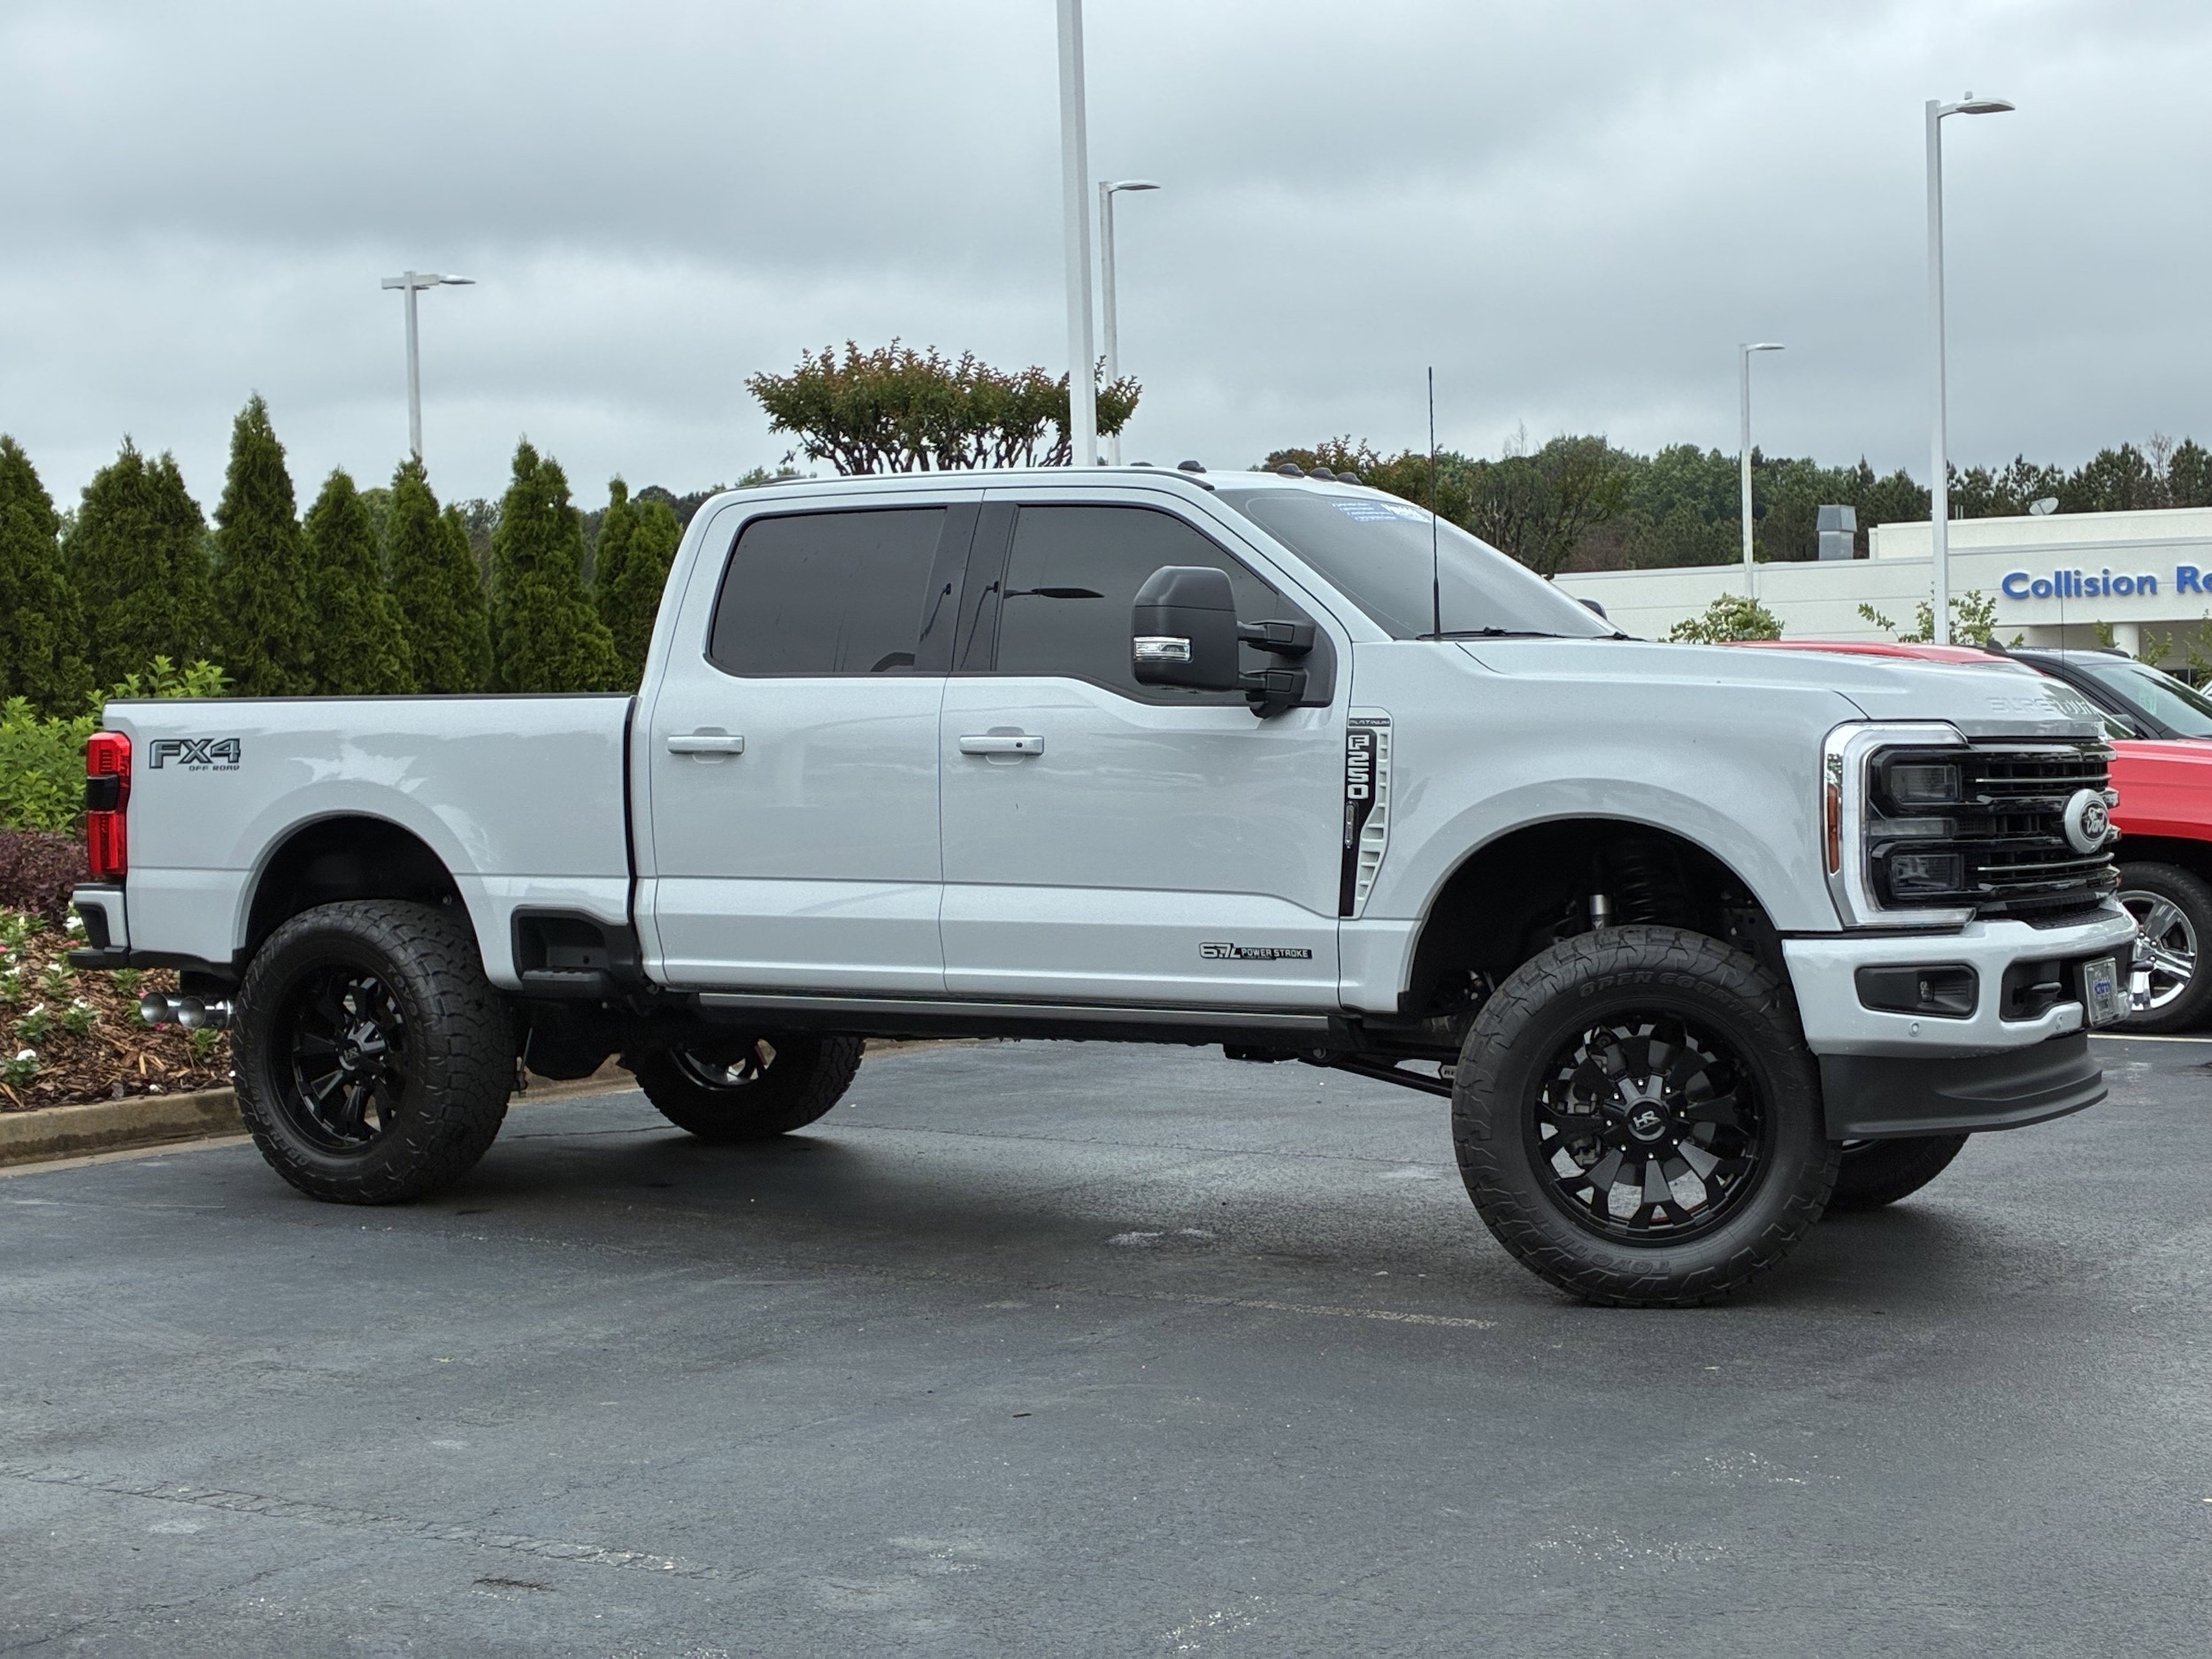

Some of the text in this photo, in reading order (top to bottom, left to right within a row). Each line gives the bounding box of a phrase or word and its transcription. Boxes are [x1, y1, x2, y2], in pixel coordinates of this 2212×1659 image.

[2001, 568, 2157, 599] Collision
[149, 738, 241, 769] FX4
[2083, 806, 2107, 834] Ford
[1199, 942, 1241, 959] 6.7L
[1241, 949, 1272, 957] POWER
[1273, 949, 1309, 958] STROKE
[1577, 971, 1654, 999] OPEN
[1588, 1250, 1671, 1274] TOYO
